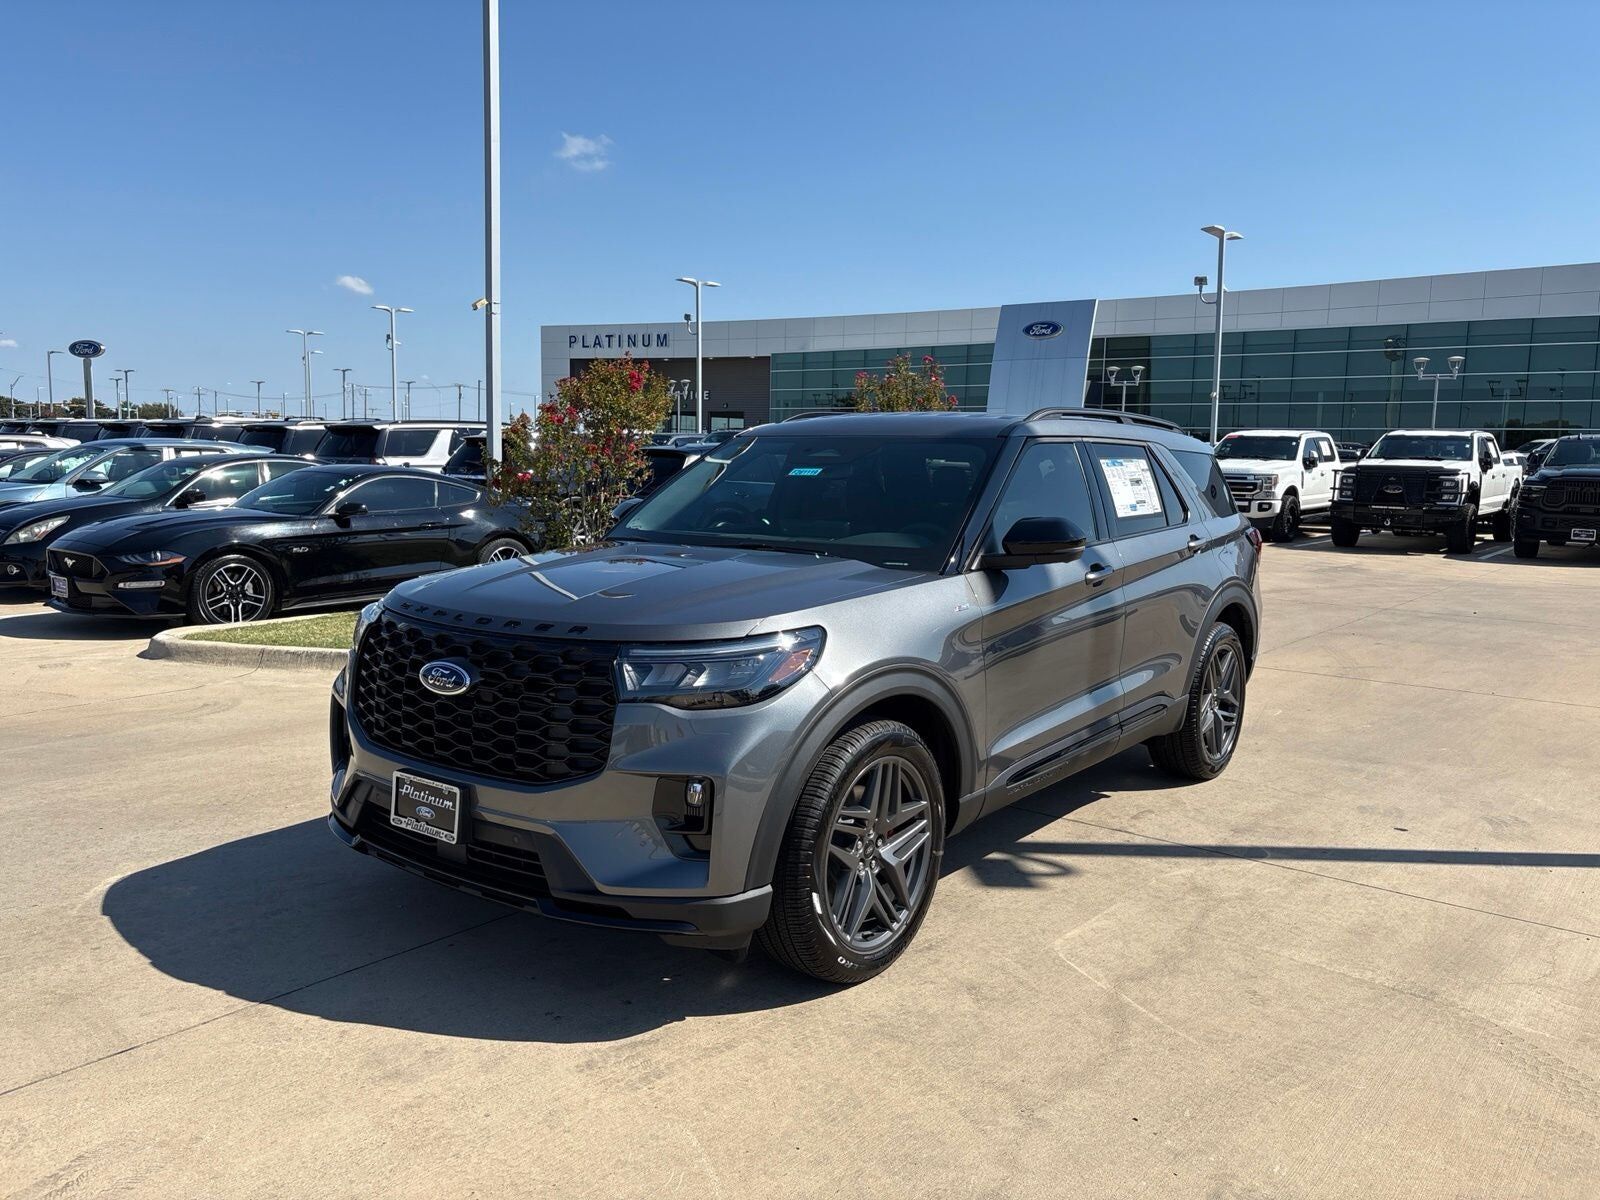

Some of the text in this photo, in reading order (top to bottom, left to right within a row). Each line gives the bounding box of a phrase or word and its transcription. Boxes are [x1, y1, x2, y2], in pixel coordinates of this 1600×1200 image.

[569, 333, 670, 348] PLATINUM
[400, 602, 589, 634] EXPLORER
[428, 667, 456, 688] Ford
[399, 784, 456, 811] Platinum
[405, 819, 443, 839] Platinum
